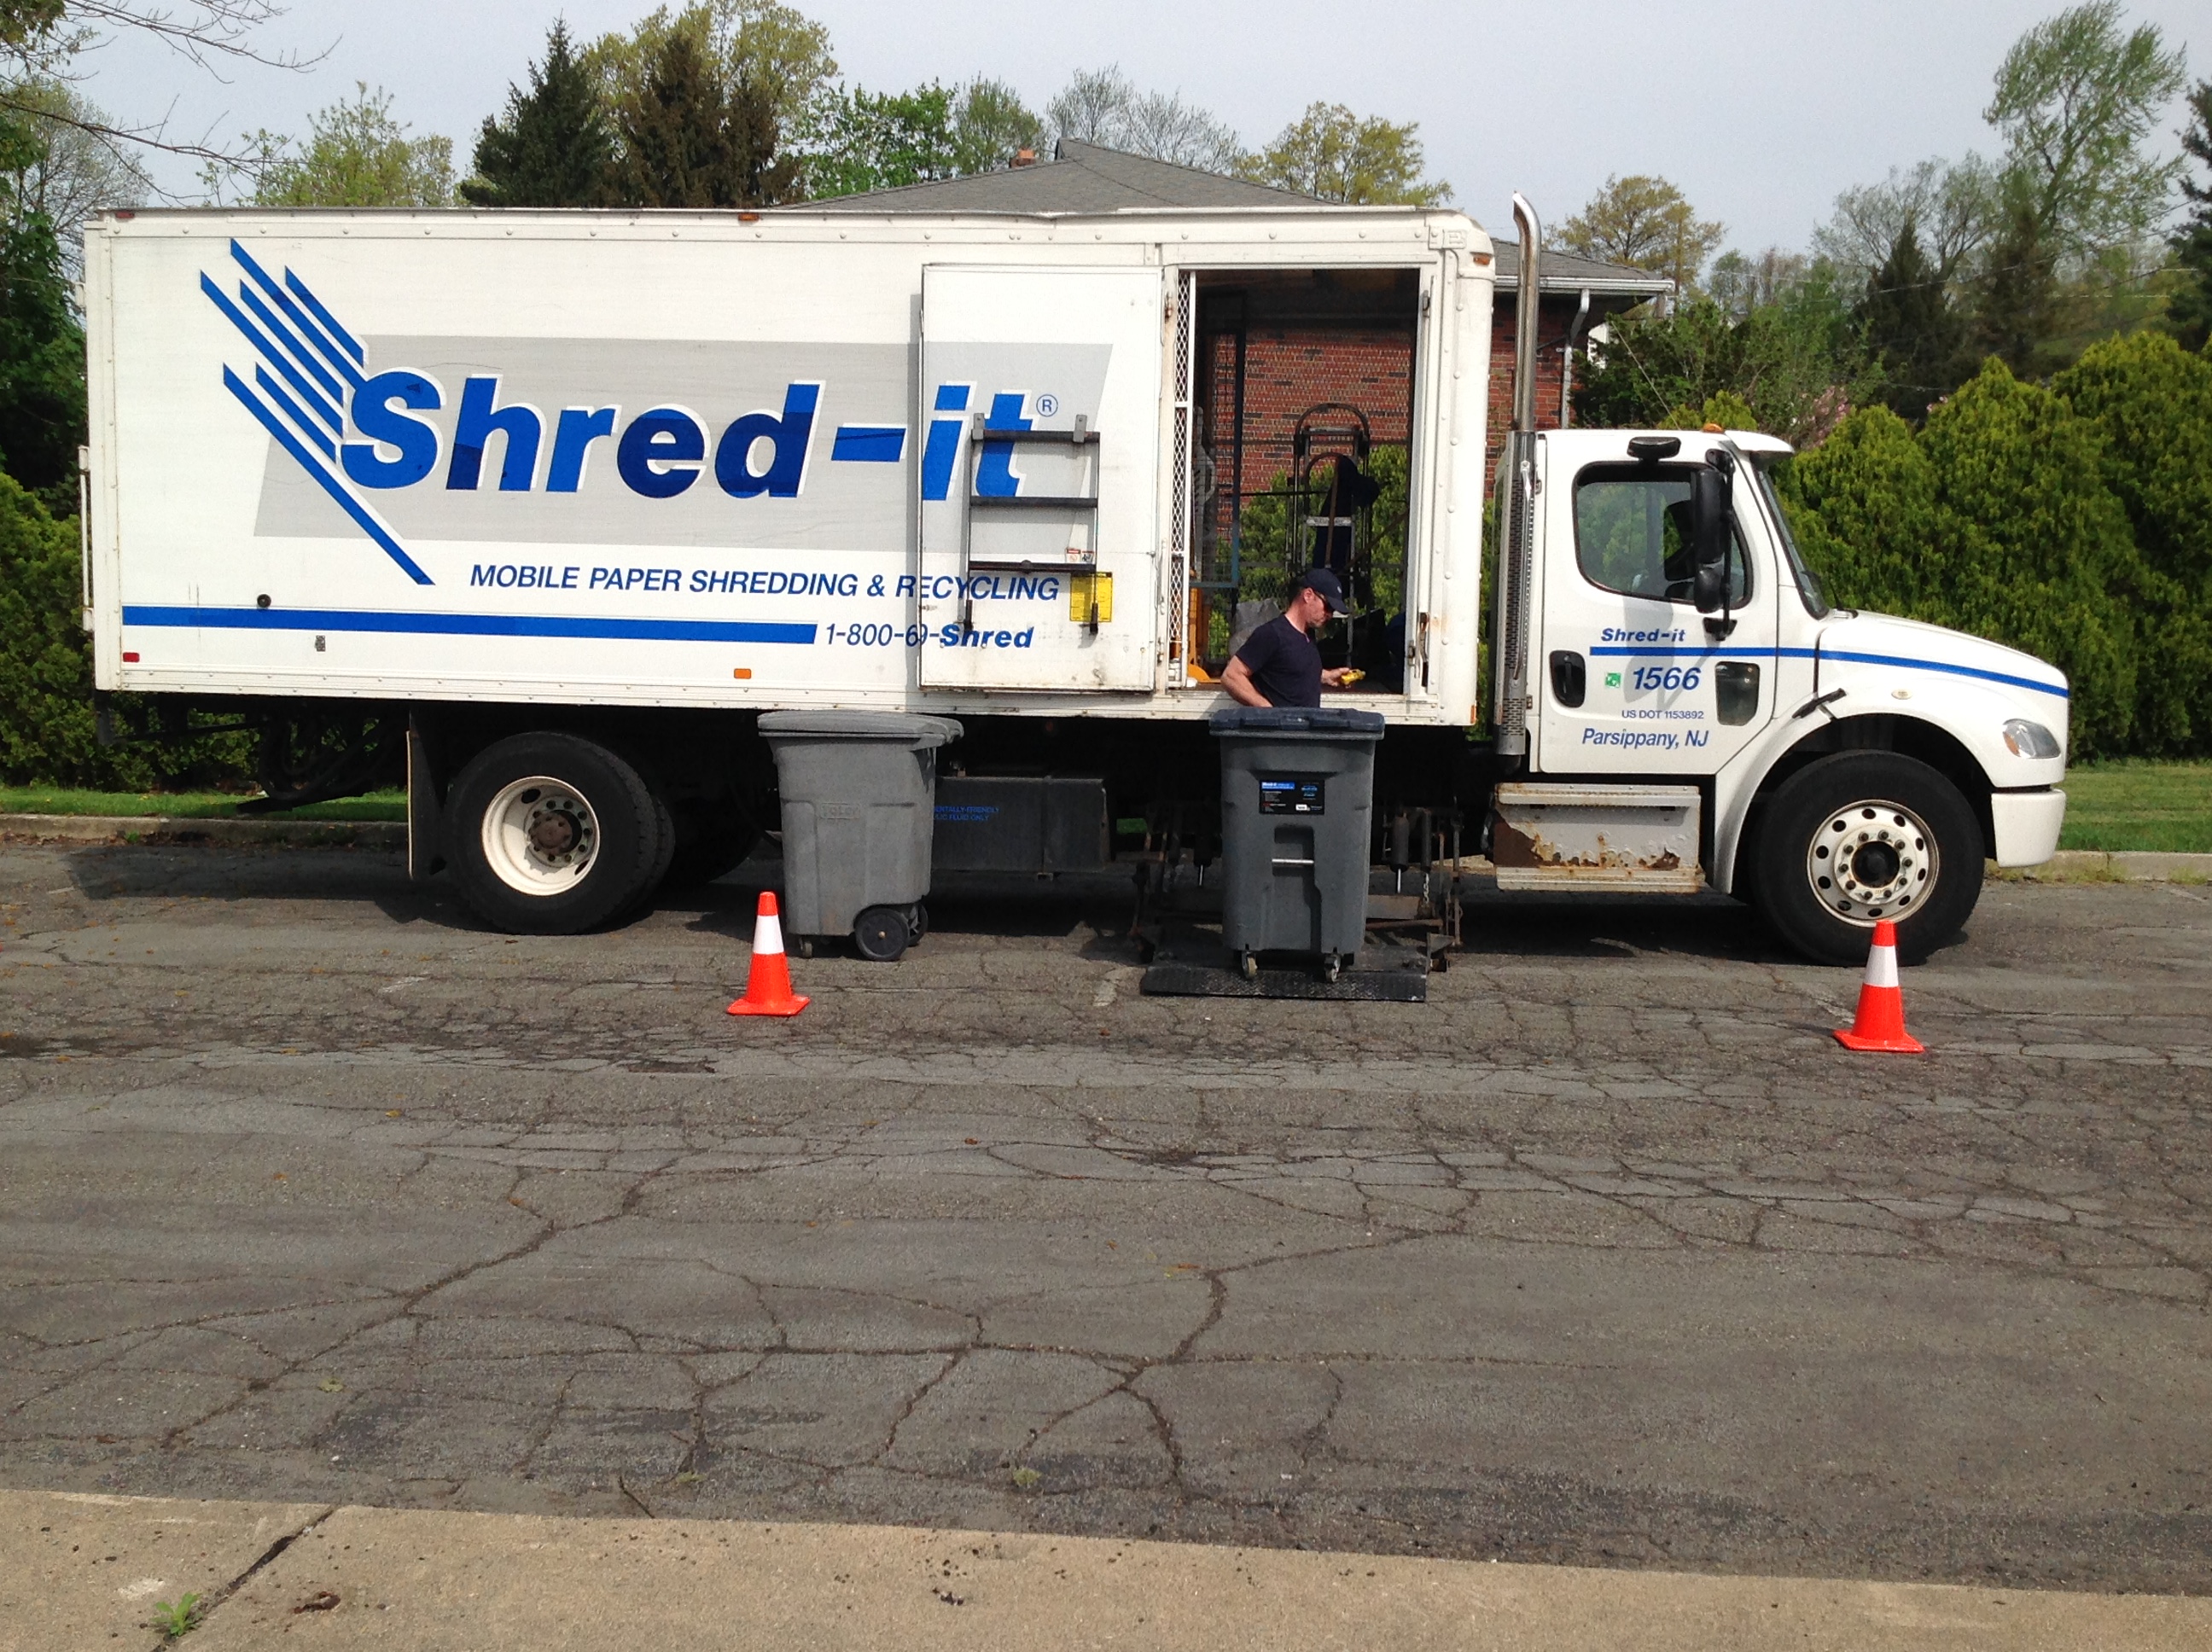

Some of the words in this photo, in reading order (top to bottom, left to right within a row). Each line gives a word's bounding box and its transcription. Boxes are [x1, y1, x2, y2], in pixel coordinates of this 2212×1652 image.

[341, 369, 1034, 503] Shred-it
[470, 564, 580, 588] MOBILE
[589, 567, 682, 591] PAPER
[690, 570, 858, 595] SHREDDING
[867, 575, 885, 596] &
[896, 575, 1059, 601] RECYCLING
[1601, 628, 1685, 641] Shred-it
[1633, 666, 1701, 689] 1566
[1622, 710, 1636, 719] US
[1639, 710, 1662, 719] DOT
[1664, 710, 1705, 719] 1153892
[1582, 728, 1679, 749] Parsippany,
[1685, 730, 1708, 747] NJ
